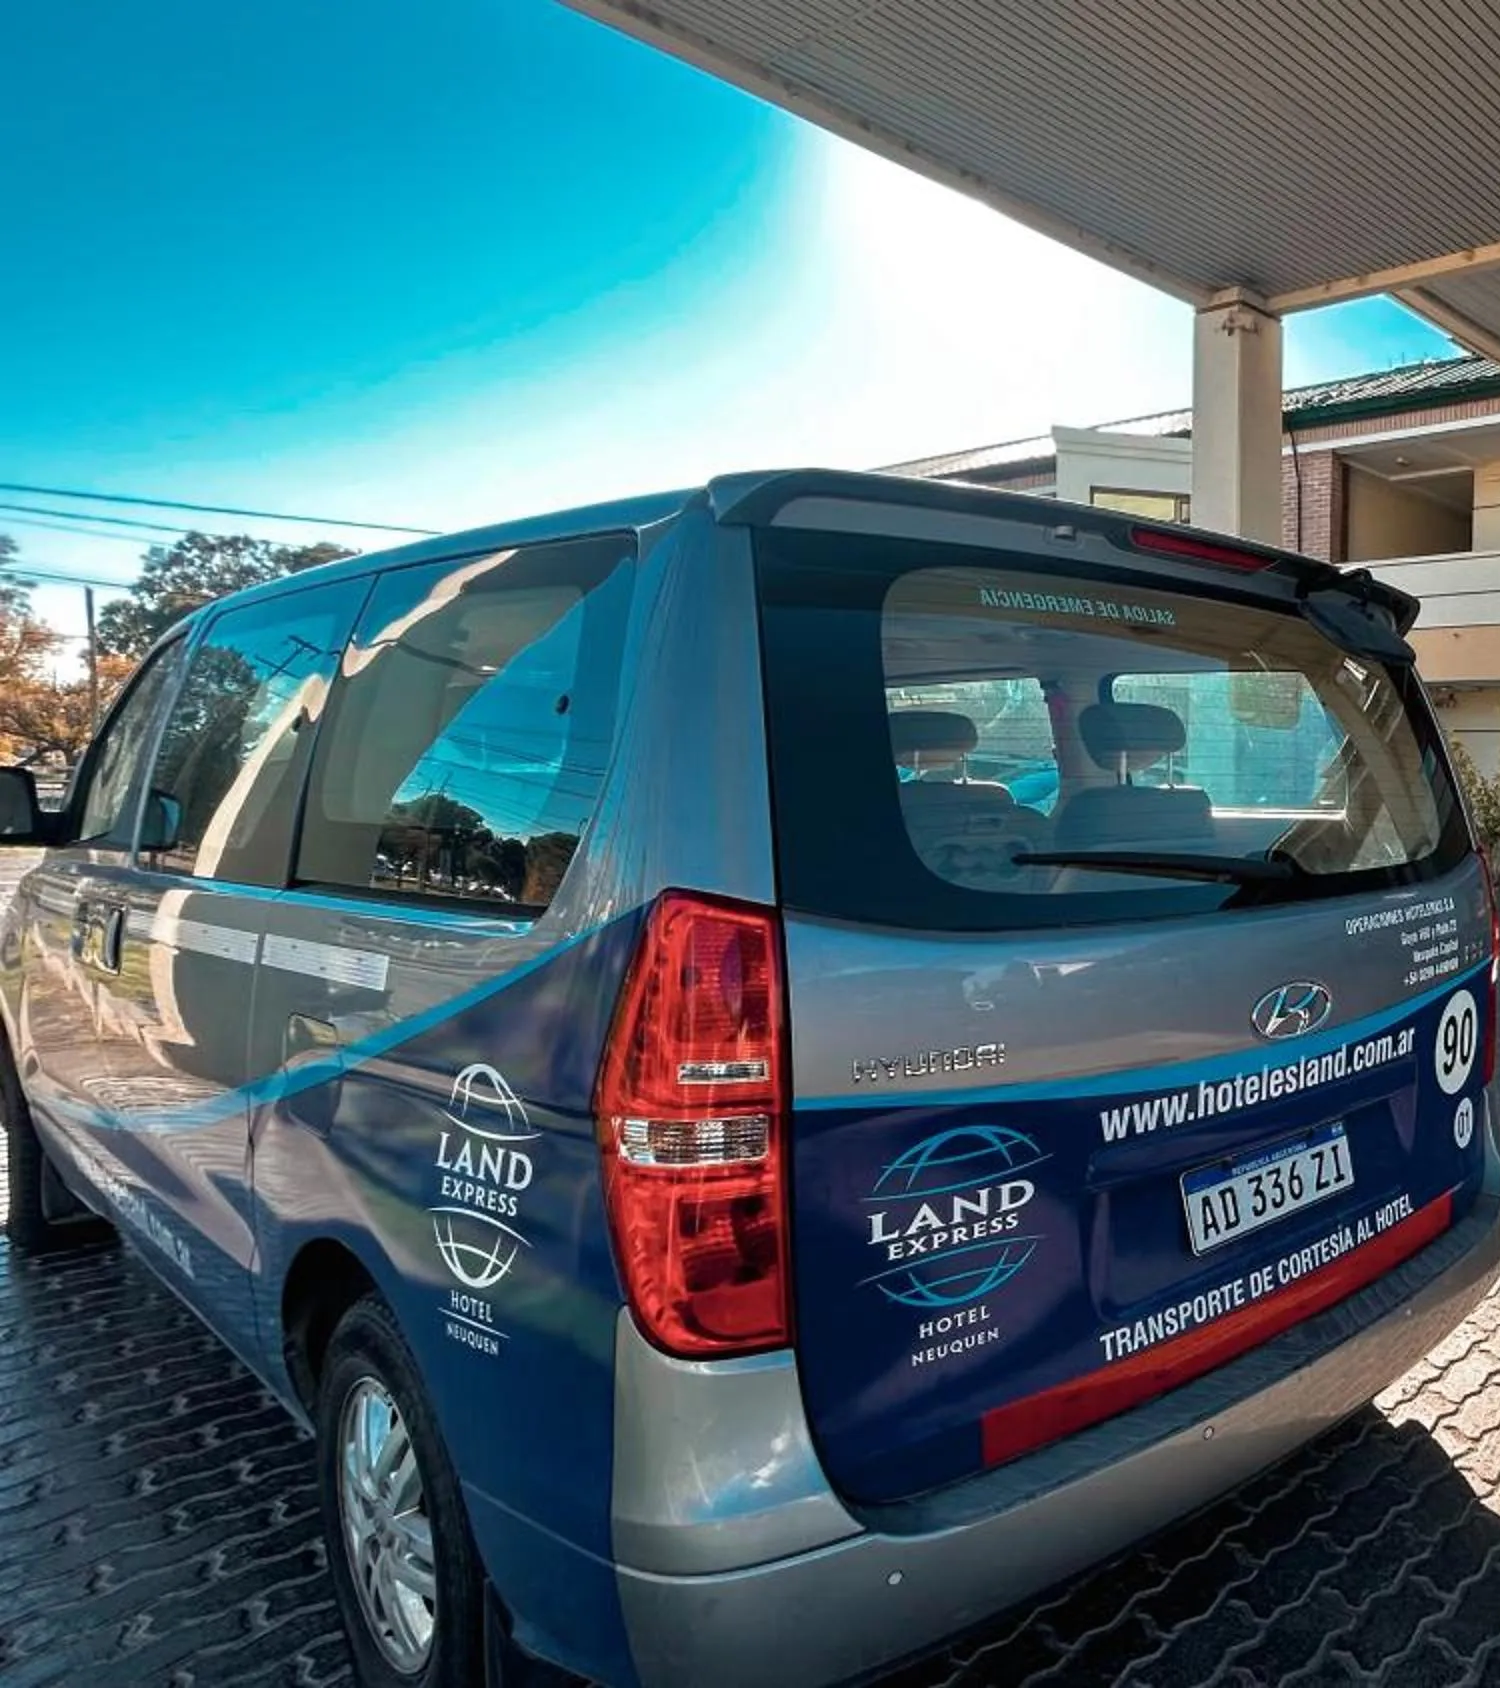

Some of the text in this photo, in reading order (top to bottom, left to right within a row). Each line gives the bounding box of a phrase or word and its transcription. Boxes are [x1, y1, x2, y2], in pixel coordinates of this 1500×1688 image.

[852, 1043, 1006, 1081] HYUNDAI
[1443, 1007, 1473, 1075] 90
[1100, 1026, 1416, 1143] www.hotelesland.com.ar
[434, 1131, 533, 1191] LAND
[441, 1175, 517, 1218] EXPRESS
[866, 1177, 1036, 1245] LAND
[1201, 1144, 1346, 1241] AD 336 ZI
[886, 1212, 1019, 1261] EXPRESS
[1099, 1193, 1414, 1361] TRANSPORTE DE CORTESÍA AL HOTEL
[450, 1289, 493, 1323] HOTEL
[918, 1304, 991, 1339] HOTEL
[446, 1322, 499, 1356] NEUQUEN
[911, 1329, 1000, 1367] NEUQUEN
